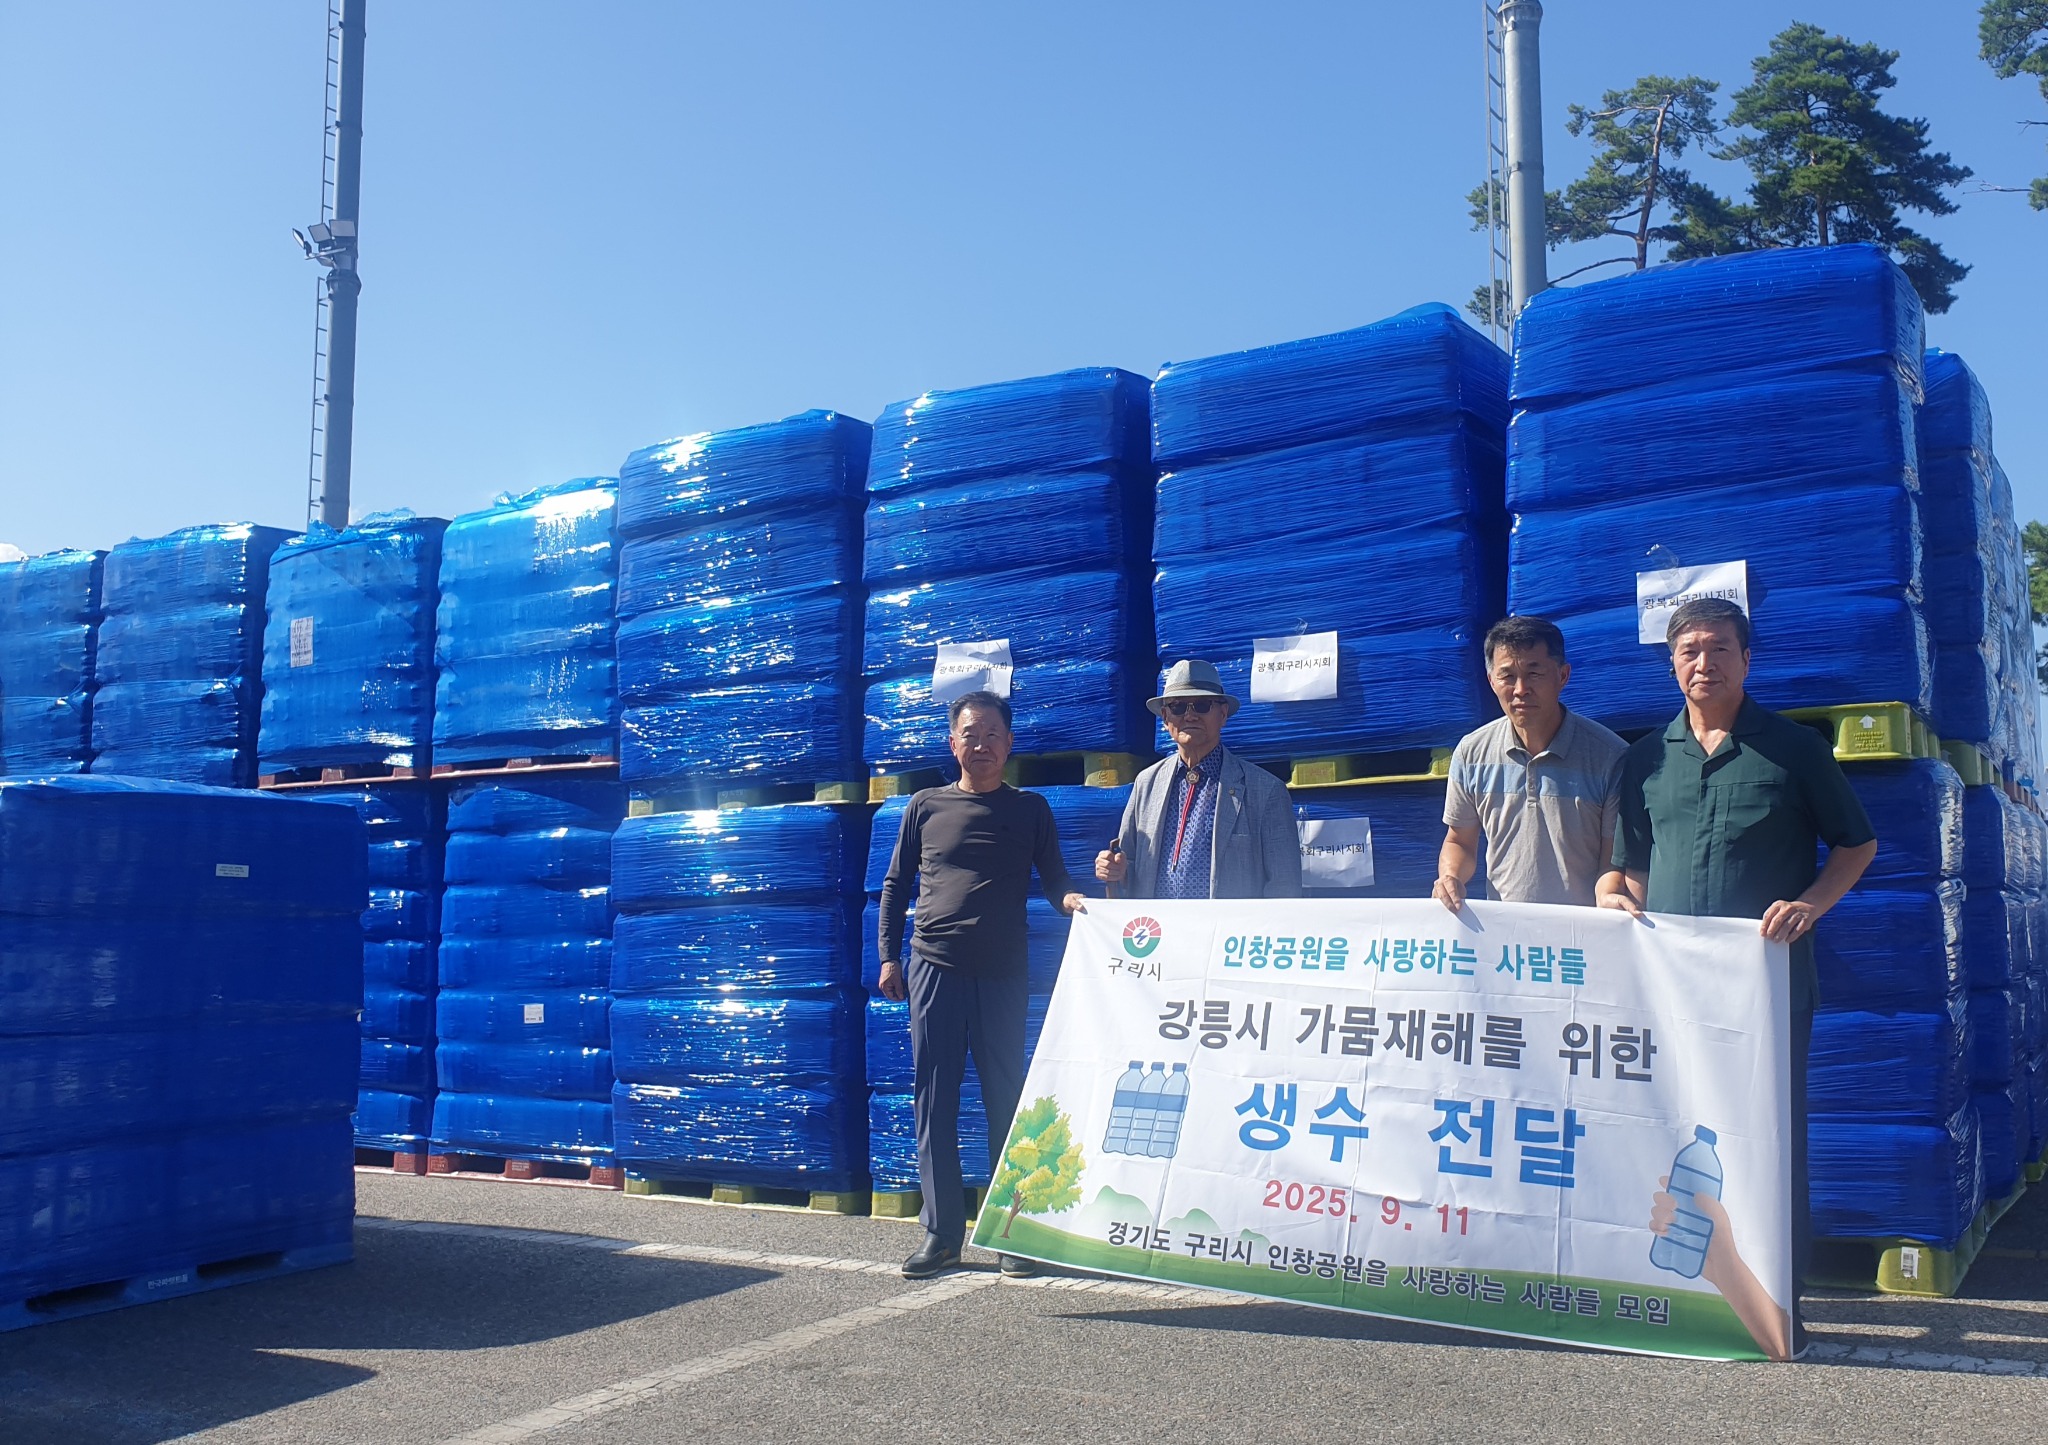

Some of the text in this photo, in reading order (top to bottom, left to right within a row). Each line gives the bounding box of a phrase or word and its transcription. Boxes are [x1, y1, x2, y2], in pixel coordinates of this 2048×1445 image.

[1257, 656, 1331, 673] 광복회구리시지회
[1107, 957, 1162, 982] 구리시
[1223, 935, 1587, 986] 인창공원을 사랑하는 사람들
[1158, 1000, 1658, 1082] 강릉시 가뭄재해를 위한
[1234, 1083, 1586, 1189] 생수 전달
[1262, 1179, 1469, 1236] 2025. 9. 11
[1107, 1221, 1671, 1326] 경기도 구리시 인창공원을 사랑하는 사람들 모임
